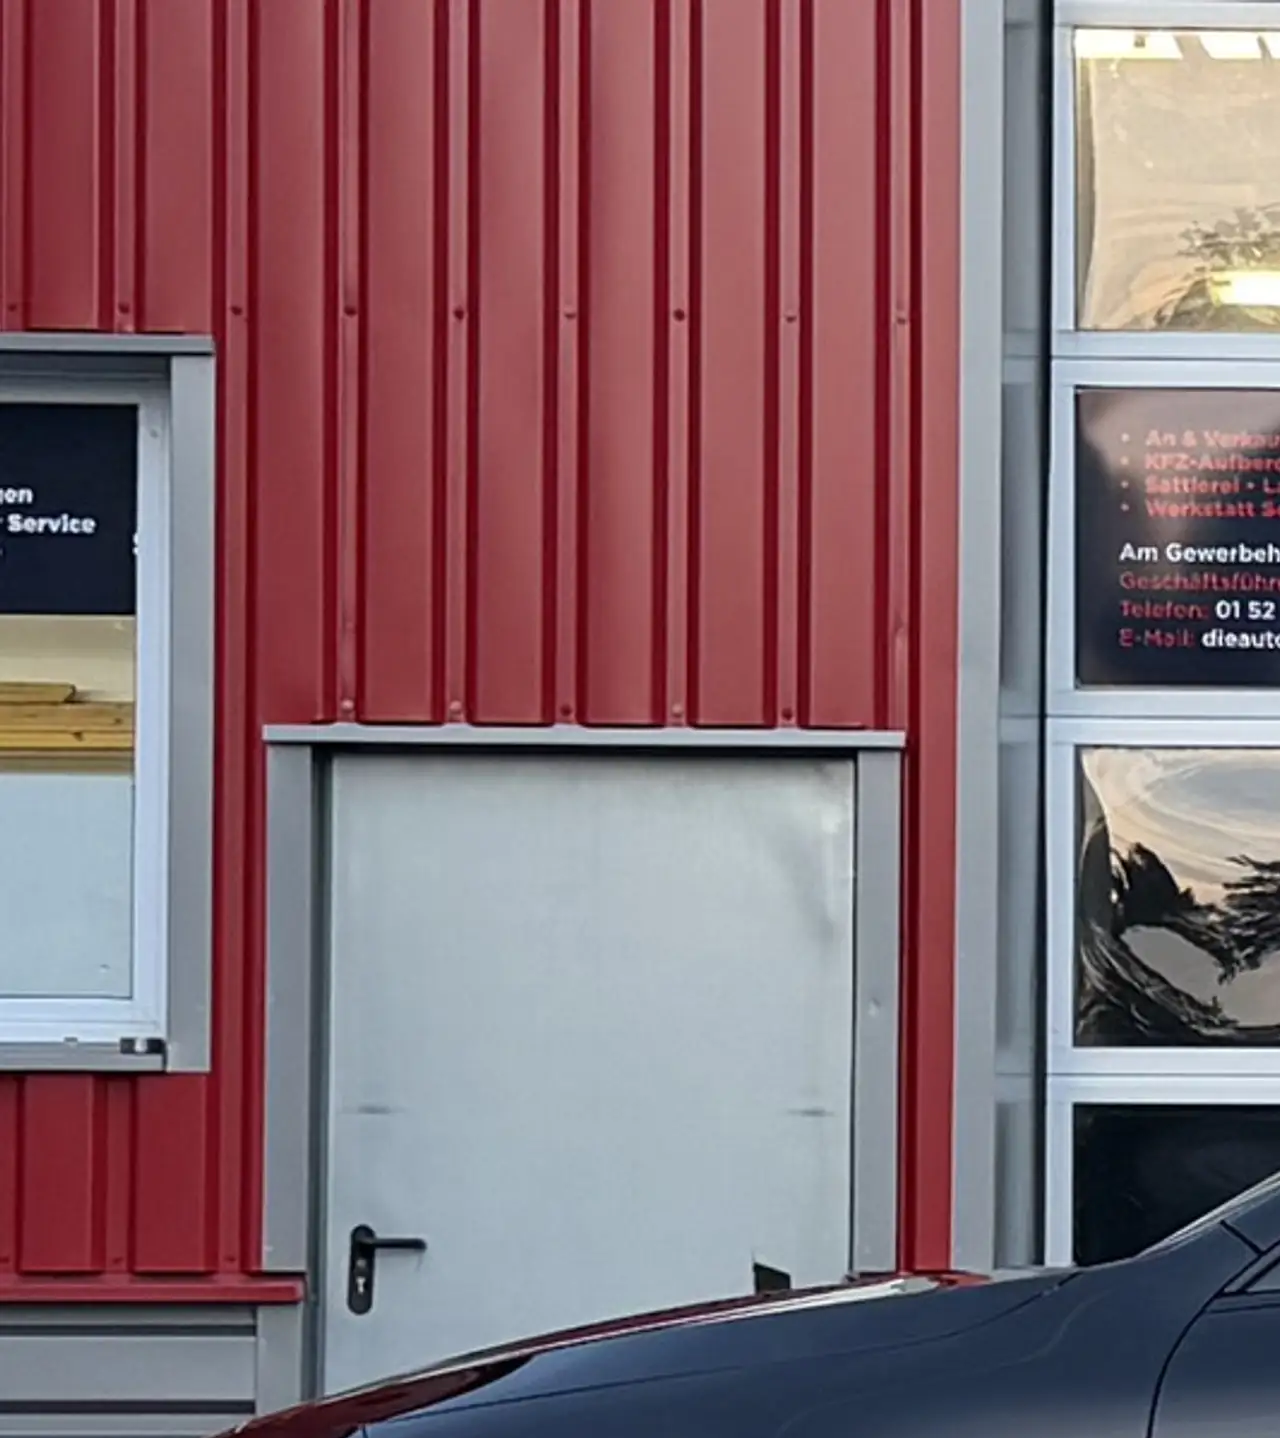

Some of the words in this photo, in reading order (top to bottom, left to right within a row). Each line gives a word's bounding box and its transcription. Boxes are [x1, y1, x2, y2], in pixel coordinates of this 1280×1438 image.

[1146, 430, 1176, 446] An
[1145, 475, 1240, 493] Sattlerei
[1146, 500, 1256, 518] Werkstatt
[7, 512, 97, 534] Service
[1119, 542, 1158, 561] Am
[1121, 600, 1209, 619] Telefon:
[1215, 600, 1241, 620] 01
[1248, 602, 1276, 620] 52
[1119, 628, 1195, 648] E-Mail:
